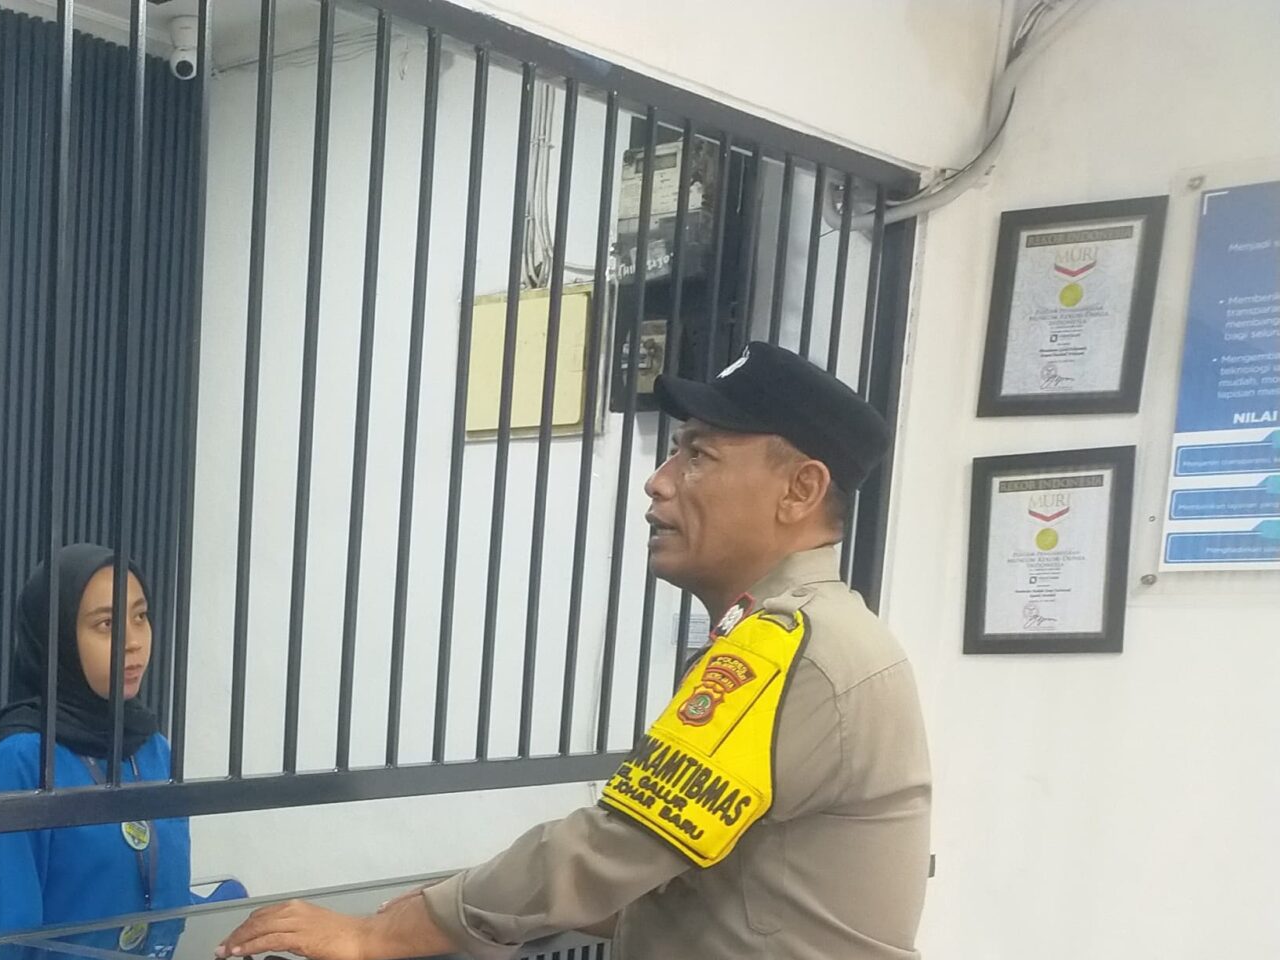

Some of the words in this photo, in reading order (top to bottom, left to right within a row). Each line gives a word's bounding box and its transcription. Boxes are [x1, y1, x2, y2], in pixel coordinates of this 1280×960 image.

[1232, 410, 1278, 425] NILAI
[612, 779, 656, 810] JOHAR
[658, 805, 704, 841] BARU
[638, 775, 688, 812] GALUR
